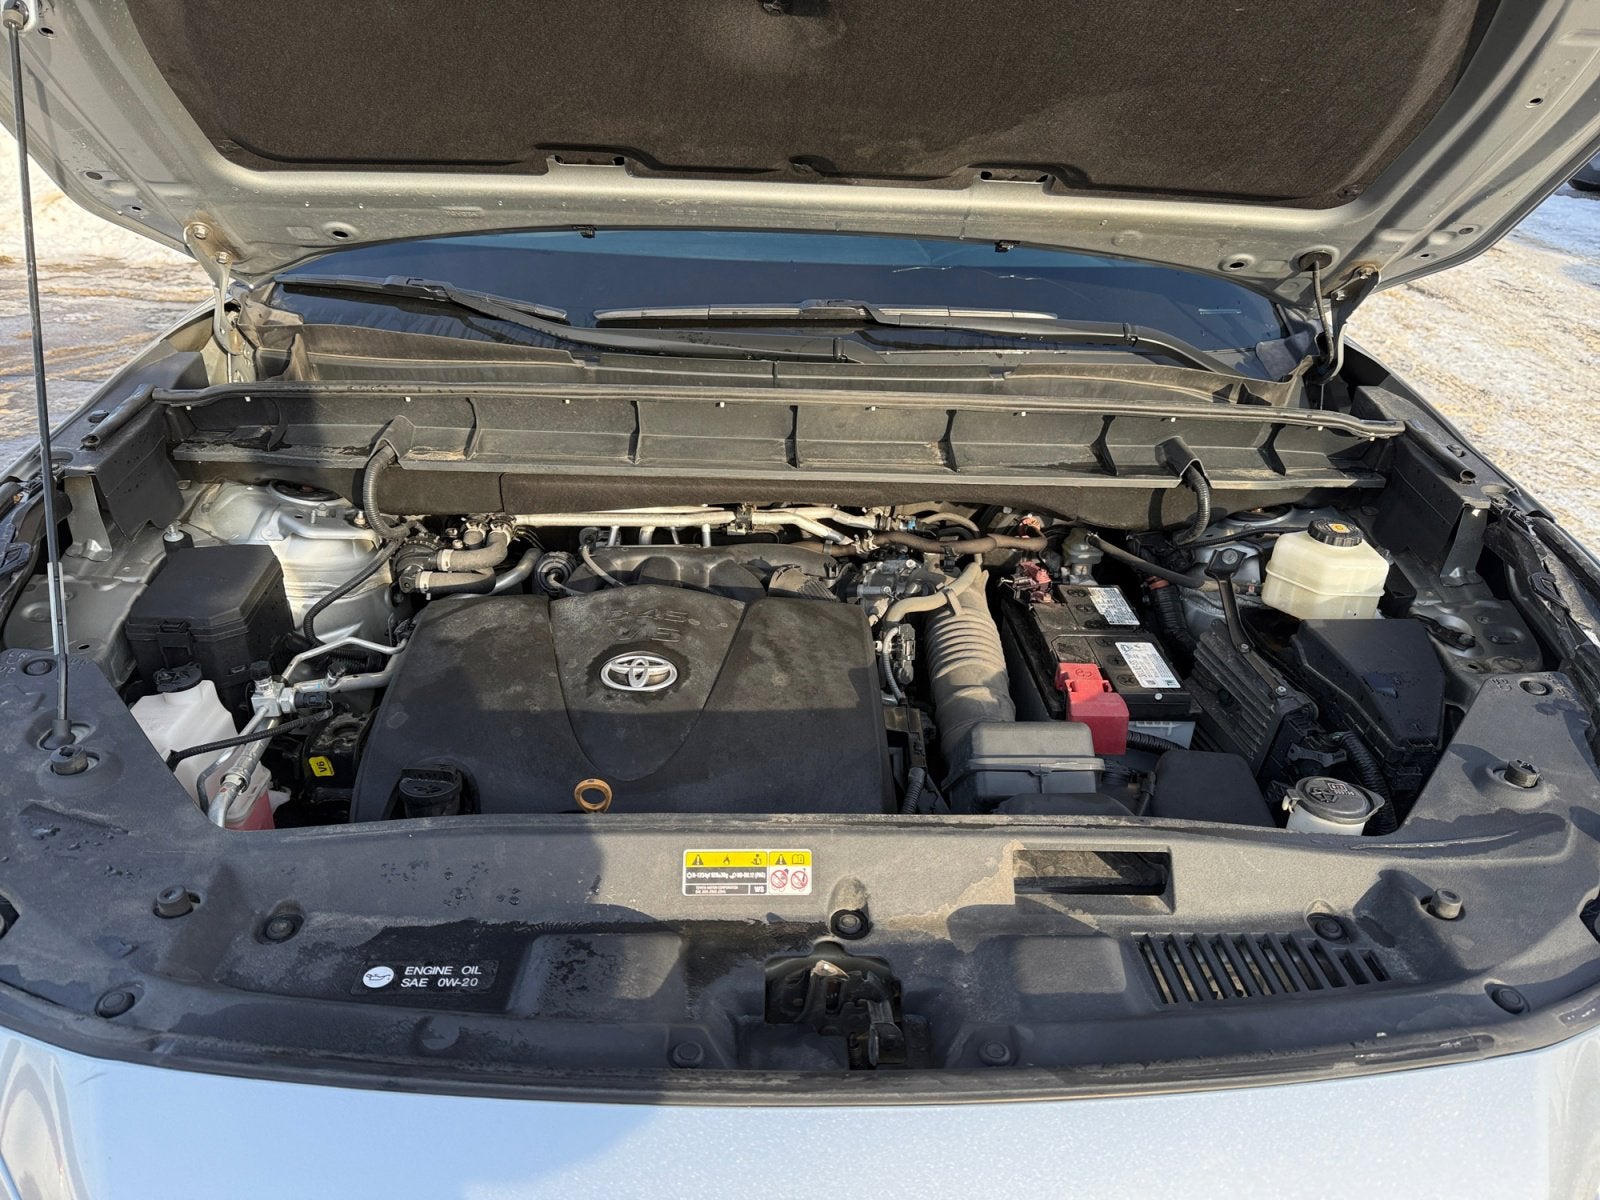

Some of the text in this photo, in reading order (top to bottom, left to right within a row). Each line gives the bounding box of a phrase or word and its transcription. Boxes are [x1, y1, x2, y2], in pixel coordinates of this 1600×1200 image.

[316, 761, 328, 773] V6
[404, 965, 483, 976] ENGINE OIL
[400, 977, 479, 988] SAE 0W-20
